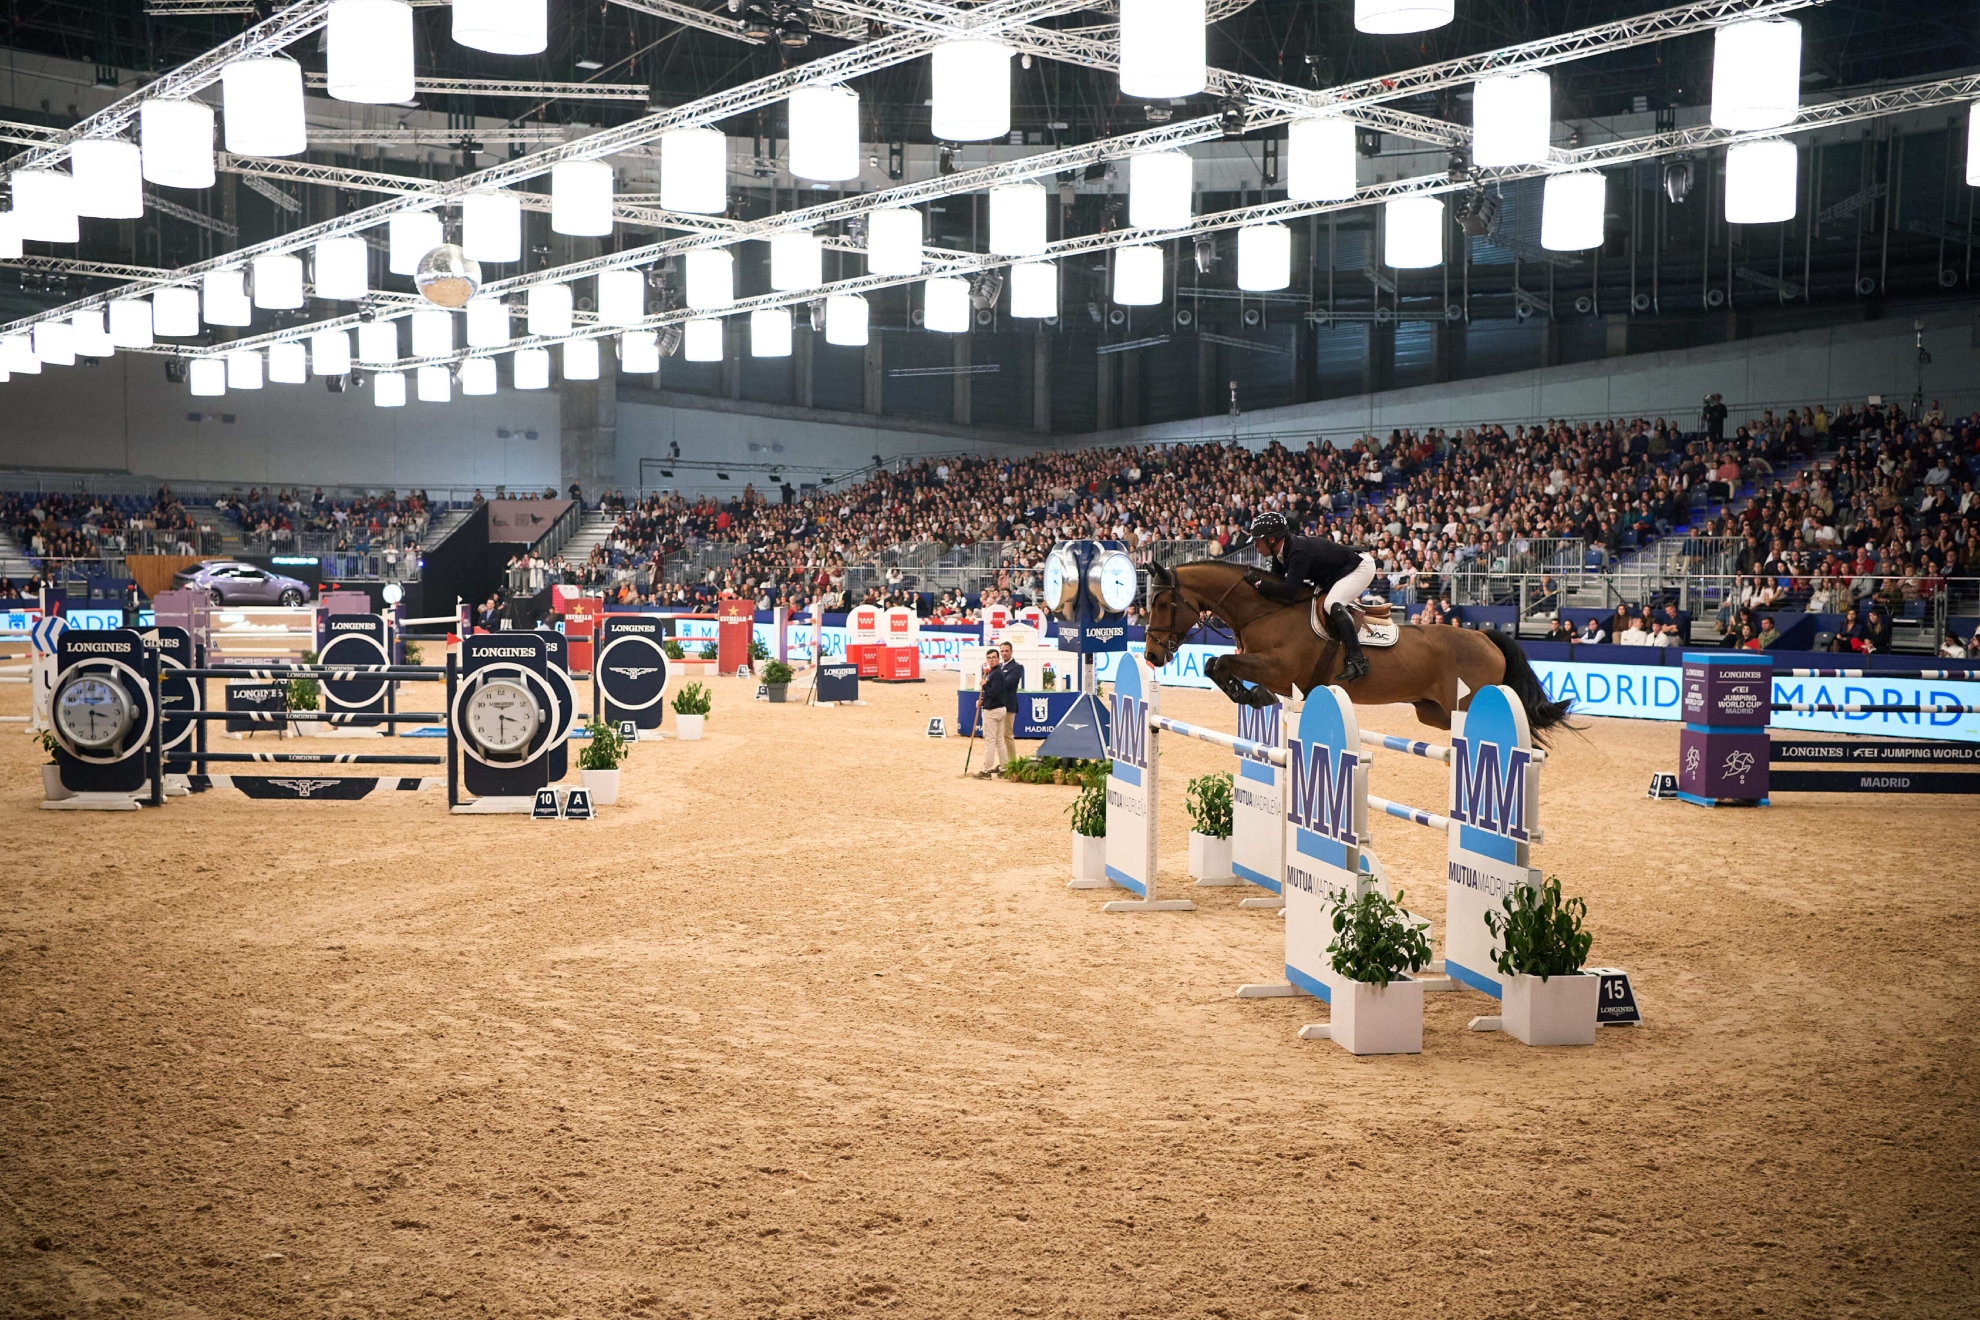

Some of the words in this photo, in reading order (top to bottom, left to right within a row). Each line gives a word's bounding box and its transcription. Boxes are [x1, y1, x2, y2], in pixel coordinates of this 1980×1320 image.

[331, 622, 377, 631] LONGINES
[611, 624, 656, 633] LONGINES
[1059, 627, 1079, 636] LONGINES
[1086, 628, 1124, 638] LONGINES
[66, 641, 132, 653] LONGINES
[142, 638, 180, 648] GINES
[471, 647, 537, 658] LONGINES
[224, 657, 292, 665] PORSCE
[824, 668, 857, 676] LONGINES
[1719, 671, 1761, 679] LONGINES
[233, 688, 284, 699] LONGINES
[1773, 682, 1963, 726] MADRID
[624, 724, 631, 733] B
[932, 719, 939, 728] 4
[1782, 747, 1844, 757] LONGINES
[1881, 749, 1931, 758] JUMPING
[1933, 749, 1973, 758] WORLD
[1665, 777, 1671, 787] 9
[1860, 778, 1910, 788] MADRID
[1287, 738, 1358, 846] MM
[1450, 737, 1530, 842] MM
[540, 793, 552, 804] 10
[573, 794, 583, 805] A
[1604, 980, 1625, 999] 15
